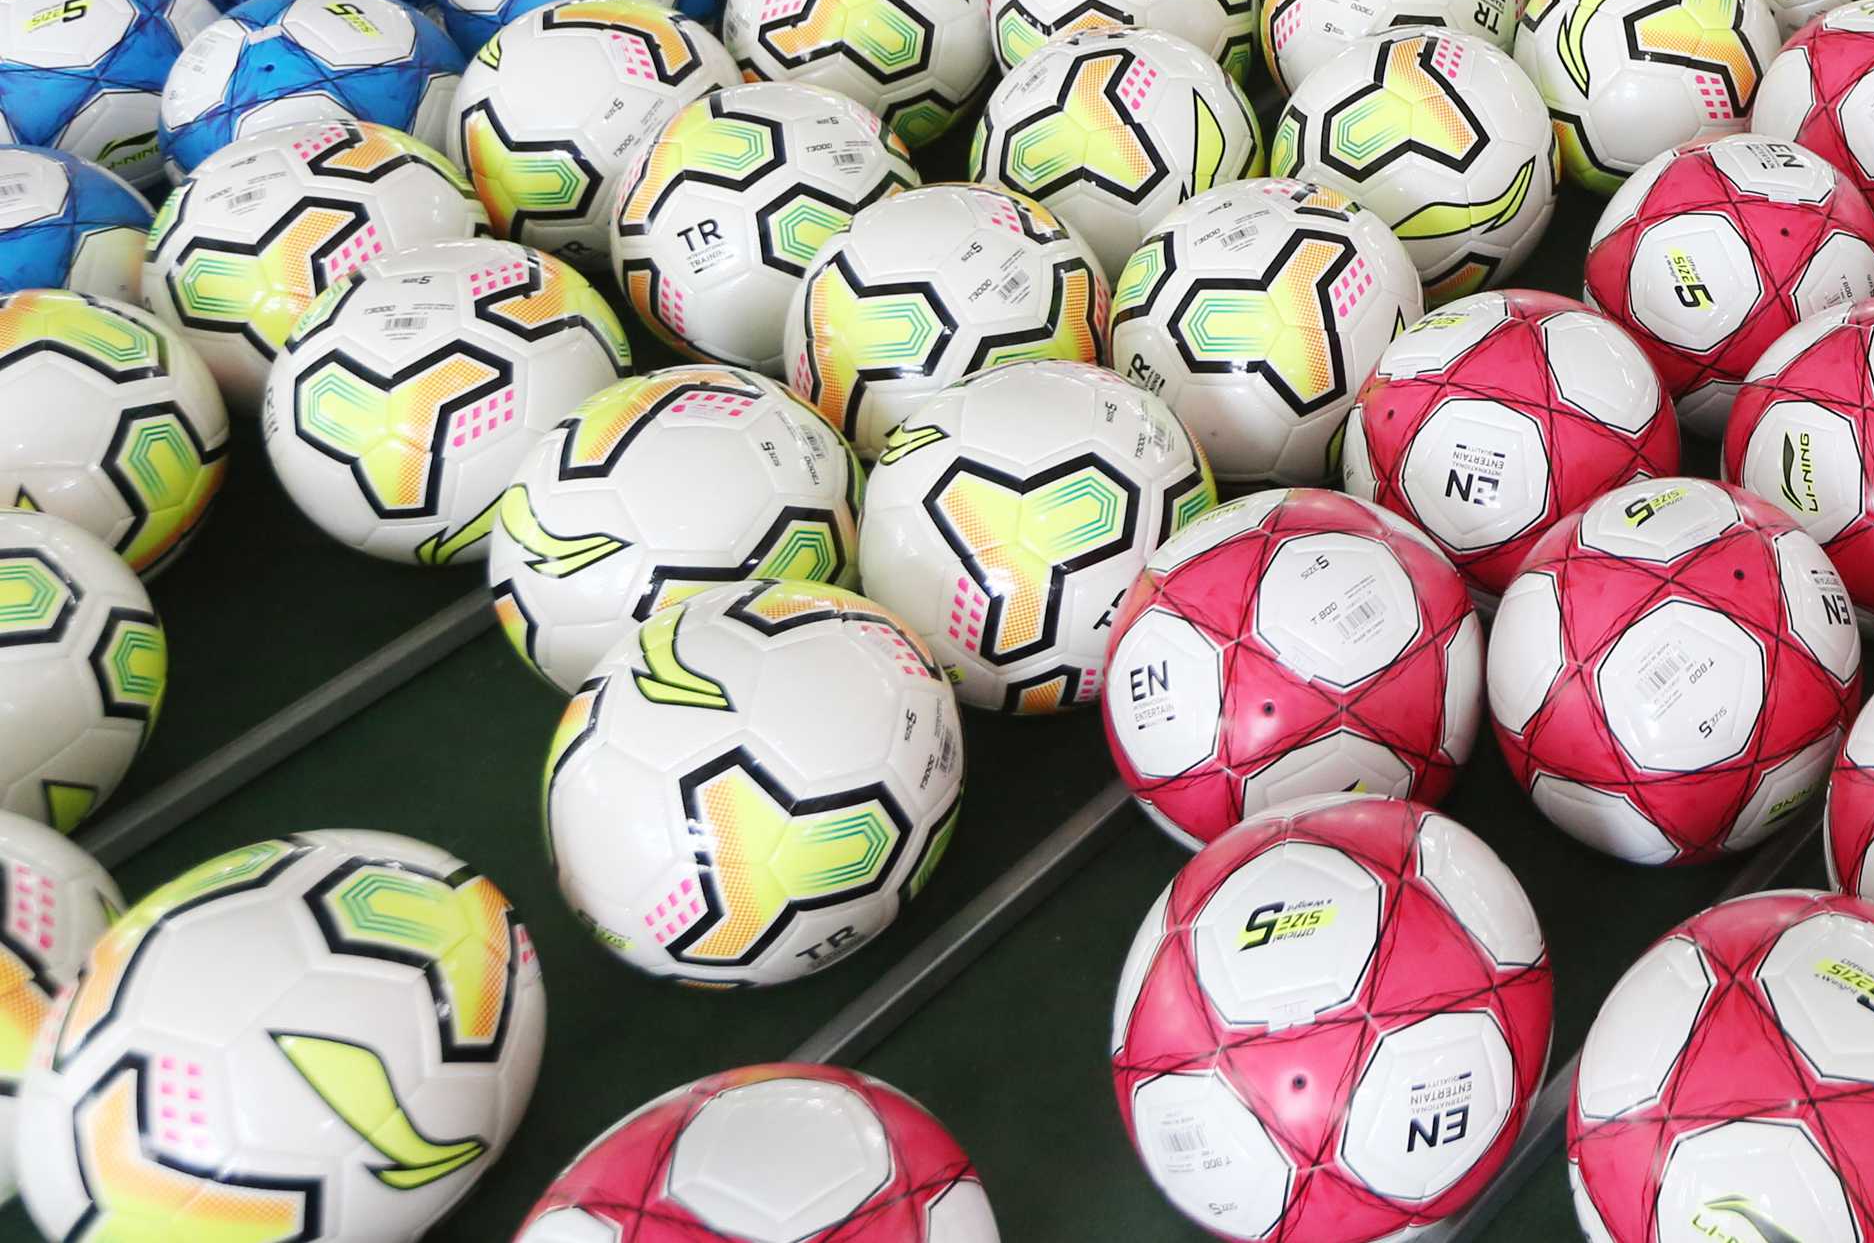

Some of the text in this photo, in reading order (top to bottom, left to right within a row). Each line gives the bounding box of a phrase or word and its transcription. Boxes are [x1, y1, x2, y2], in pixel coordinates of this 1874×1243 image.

[30, 9, 62, 27] SIZE
[1474, 2, 1500, 34] TR
[1767, 143, 1805, 169] EN
[677, 219, 723, 251] TR
[967, 278, 994, 303] T3000
[1673, 255, 1714, 307] SIZE 5
[1452, 450, 1506, 470] ENTERTAIN
[1799, 432, 1818, 513] LI-NING
[1445, 468, 1500, 505] EN
[1624, 496, 1656, 528] 5
[1823, 594, 1850, 626] EN
[1130, 660, 1168, 702] EN
[1239, 901, 1320, 952] SIZE 5
[794, 925, 858, 961] TR
[1827, 963, 1874, 988] SIZE
[1410, 1082, 1472, 1105] ENTERTAIN
[1407, 1105, 1469, 1152] EN
